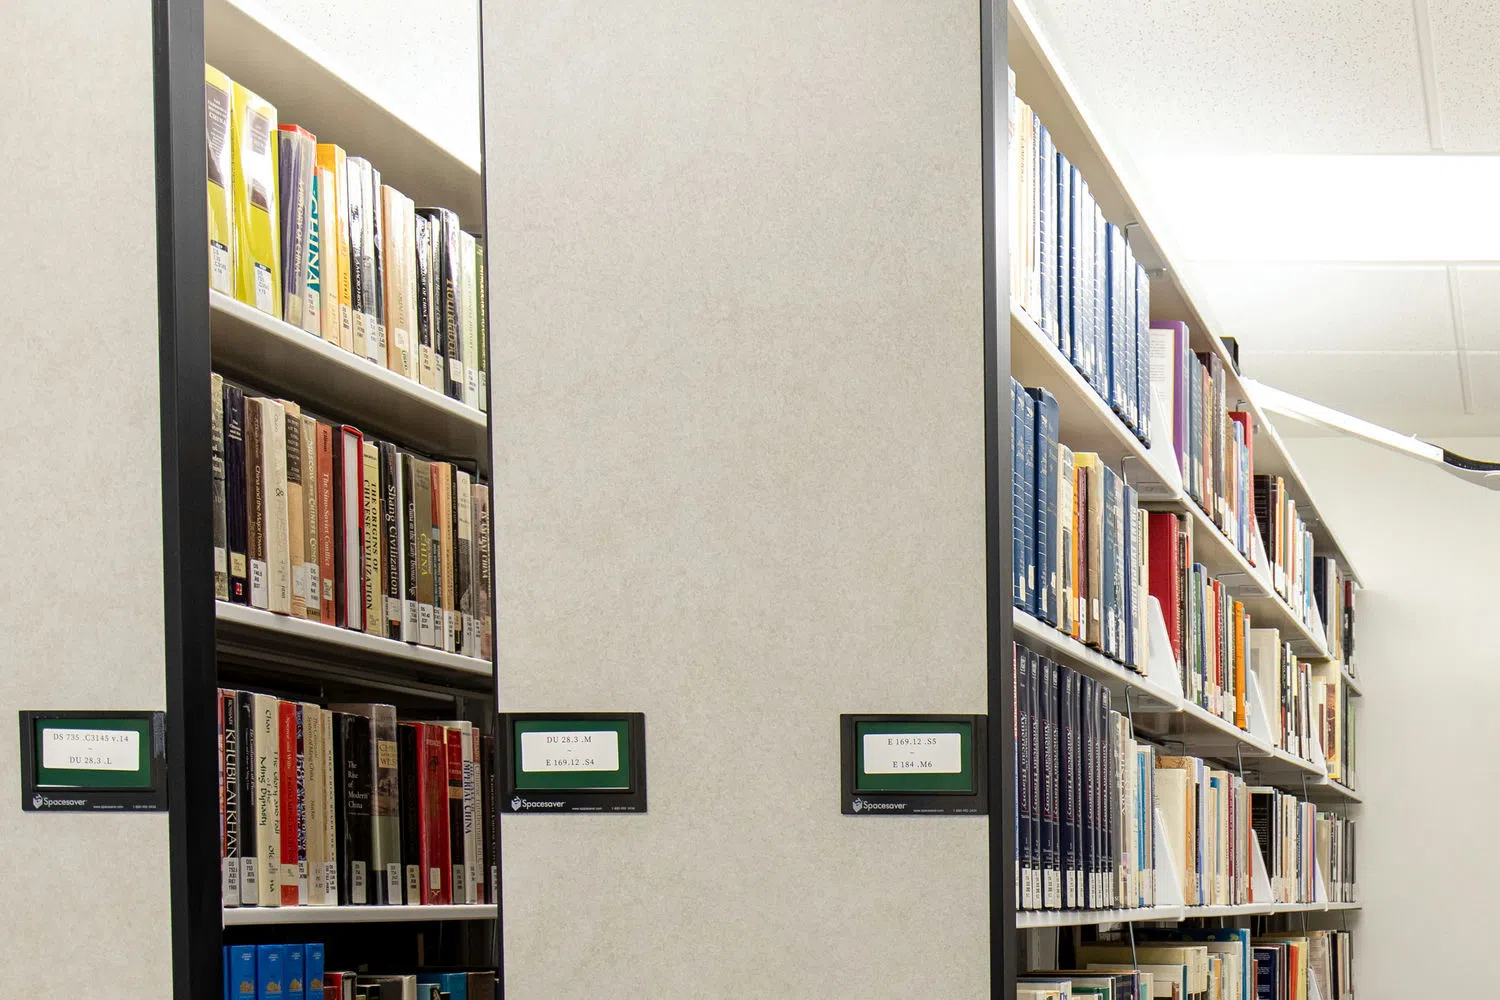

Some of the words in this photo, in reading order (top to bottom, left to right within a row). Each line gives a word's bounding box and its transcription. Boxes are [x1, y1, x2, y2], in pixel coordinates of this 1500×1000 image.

[386, 486, 396, 522] Shang
[373, 558, 378, 573] OF
[389, 525, 398, 595] Civilization
[43, 798, 86, 807] Spacesaver
[522, 800, 564, 808] Spacesaver
[863, 801, 906, 811] Spacesaver
[226, 810, 238, 858] KHAN
